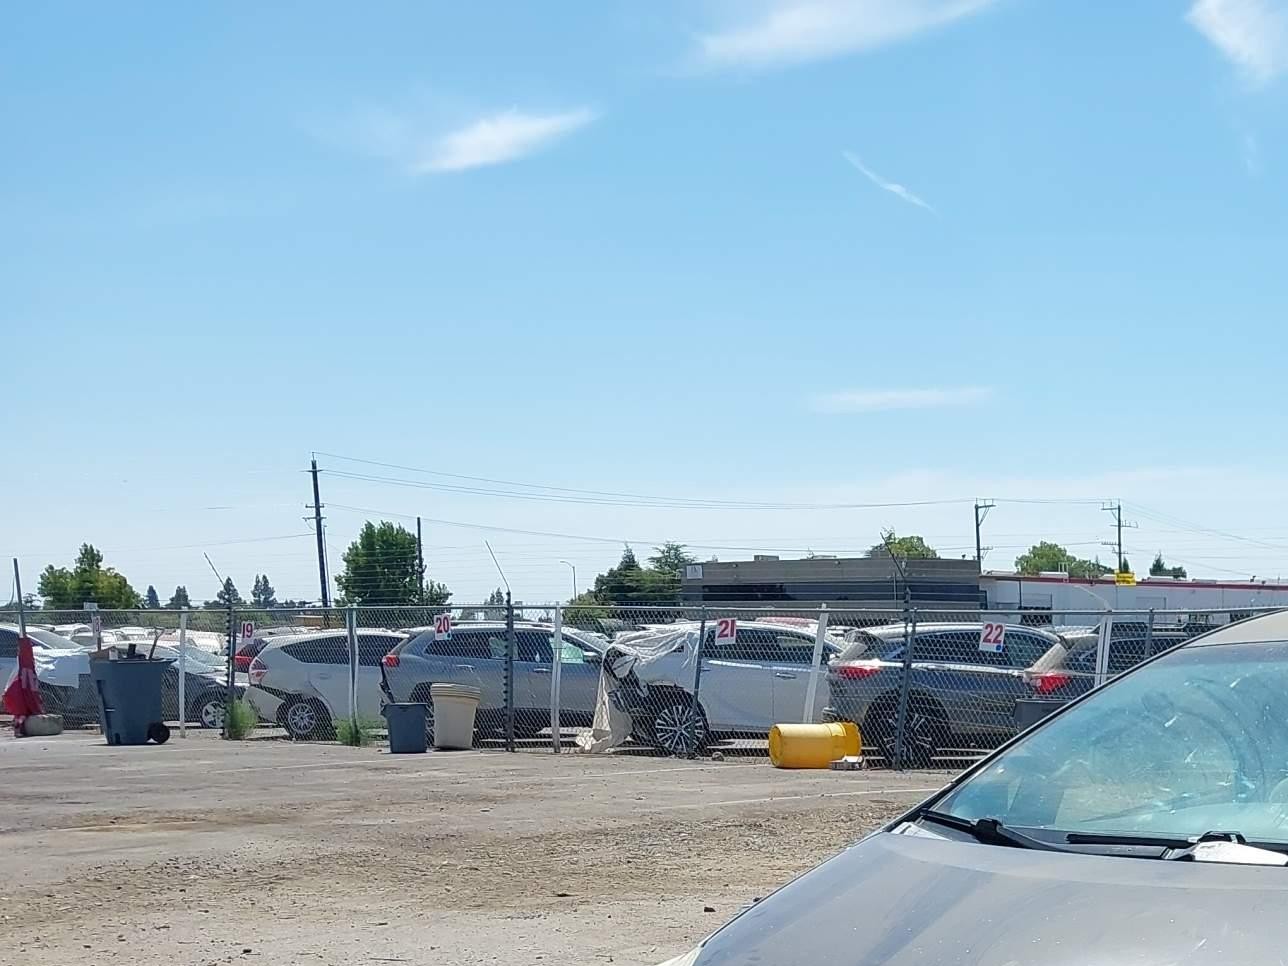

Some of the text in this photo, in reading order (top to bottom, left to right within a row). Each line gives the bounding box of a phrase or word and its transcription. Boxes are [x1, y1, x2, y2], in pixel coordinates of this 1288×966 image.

[242, 622, 253, 639] 19
[436, 616, 450, 634] 20
[717, 619, 736, 639] 21
[982, 623, 1004, 644] 22
